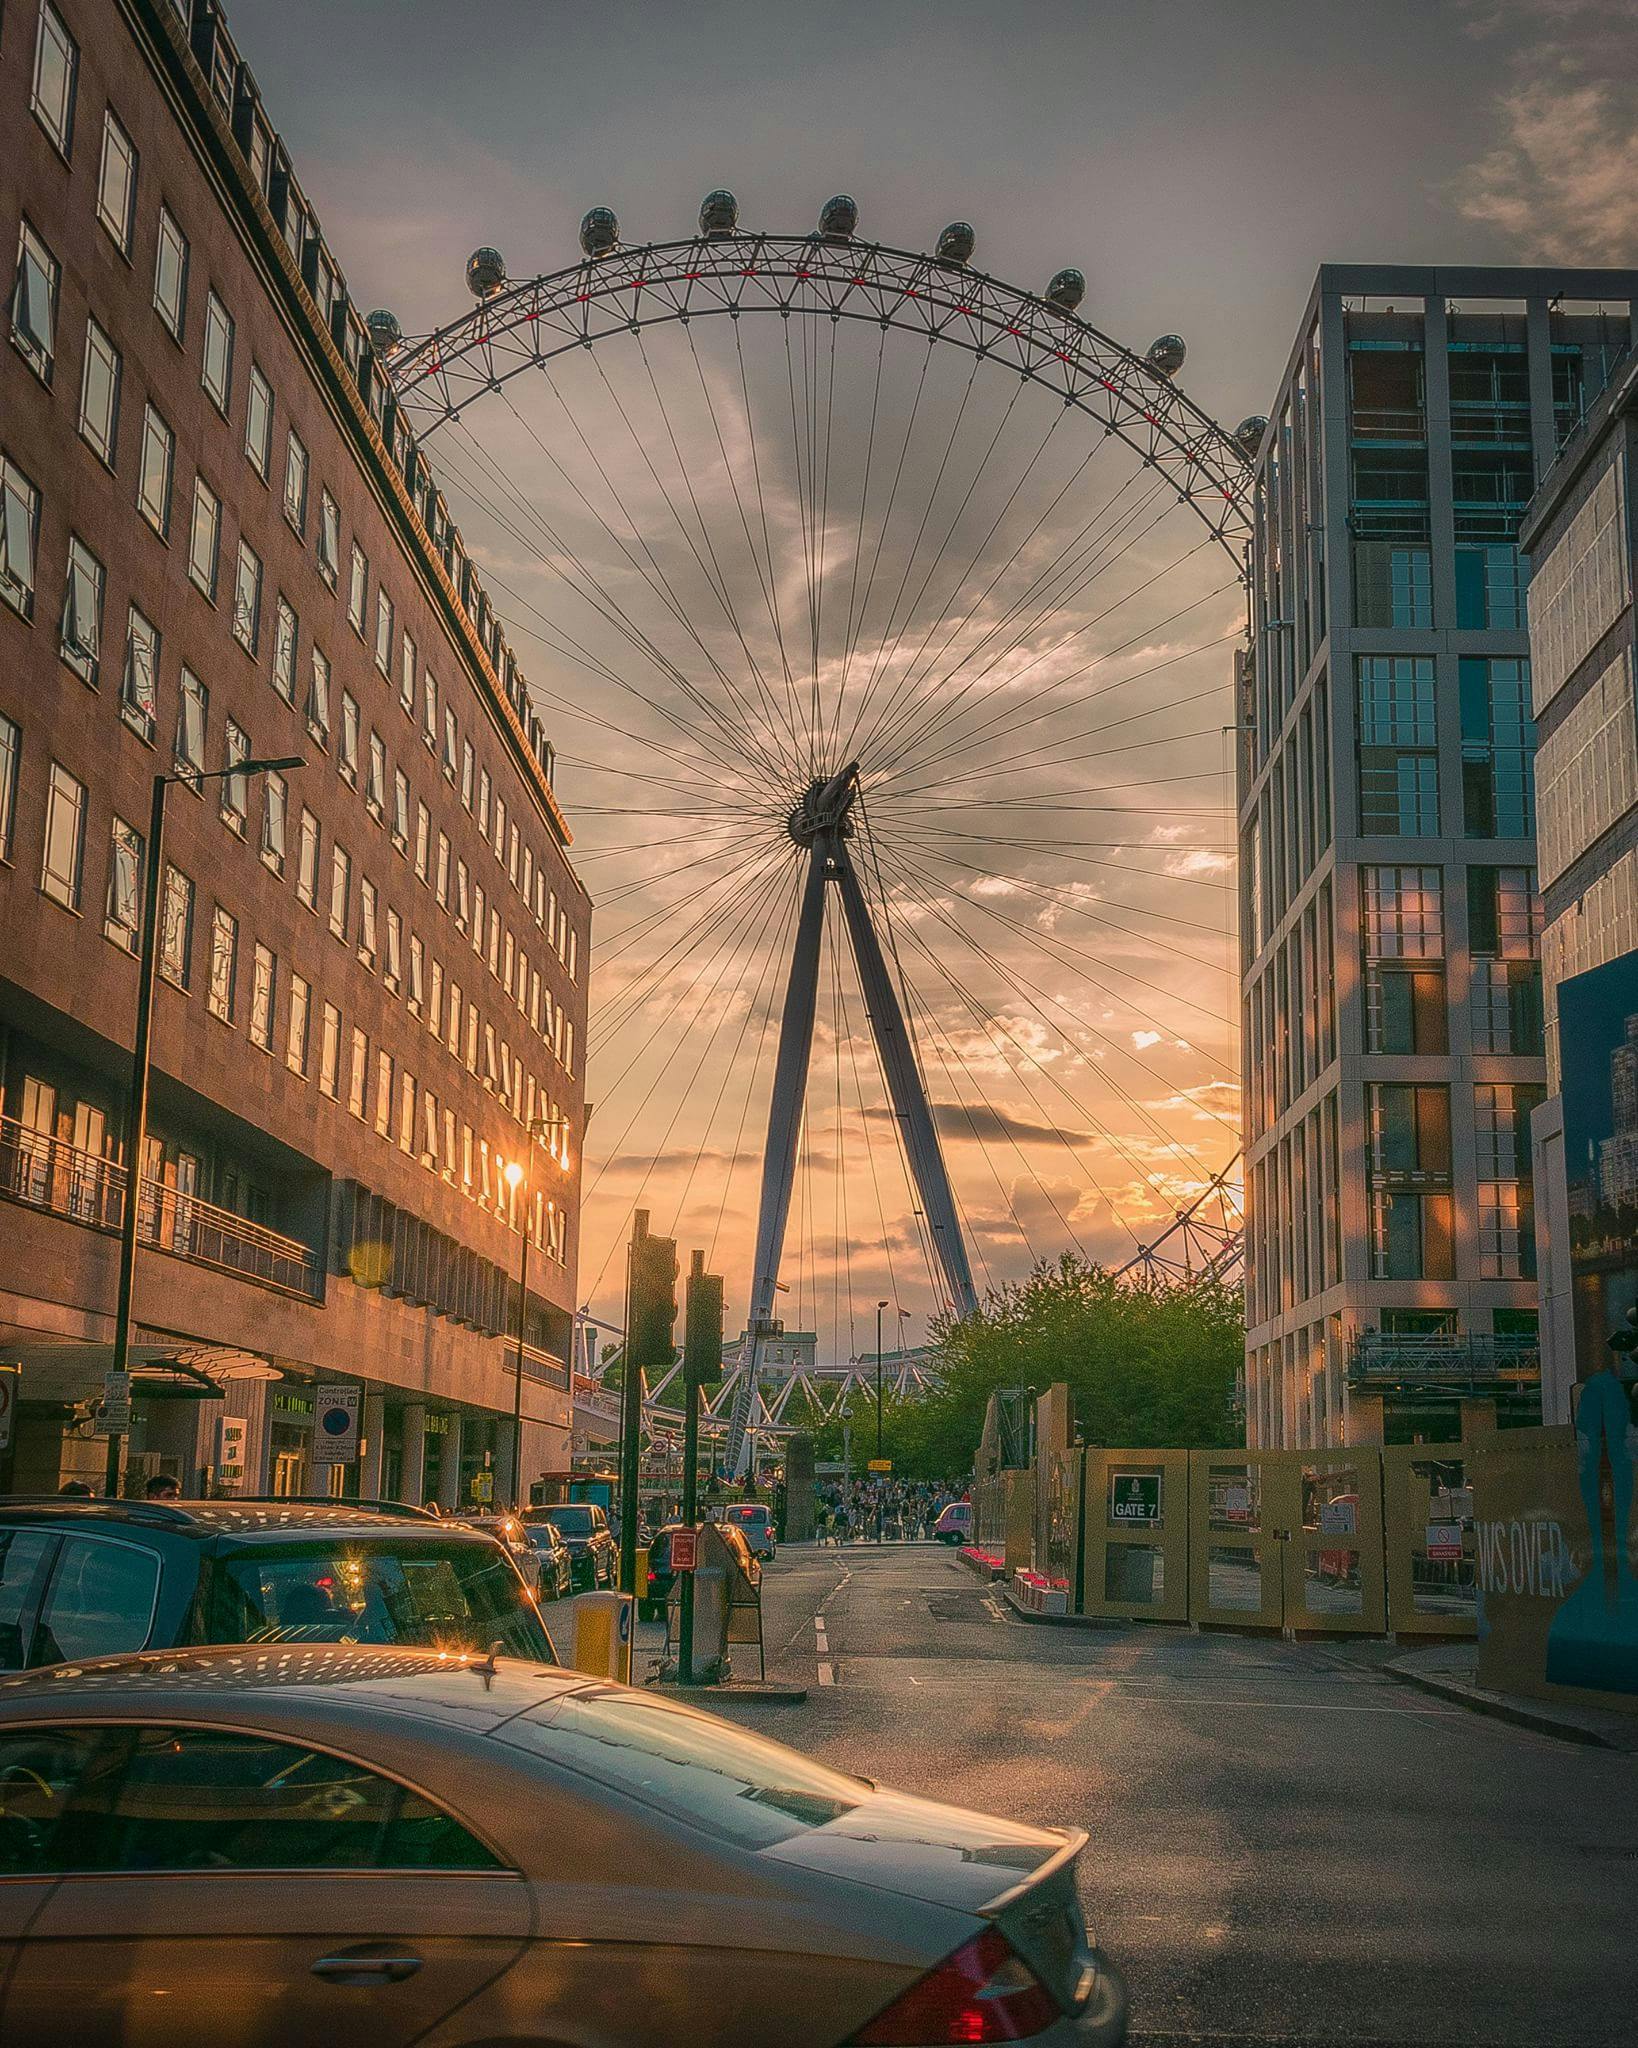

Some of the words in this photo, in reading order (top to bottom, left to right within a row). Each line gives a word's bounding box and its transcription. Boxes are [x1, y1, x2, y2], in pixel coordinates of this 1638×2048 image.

[319, 1386, 358, 1395] Controlled
[318, 1397, 346, 1405] ZONE
[1115, 1503, 1145, 1516] GATE
[1148, 1503, 1156, 1517] 7
[1510, 1520, 1565, 1598] OVER
